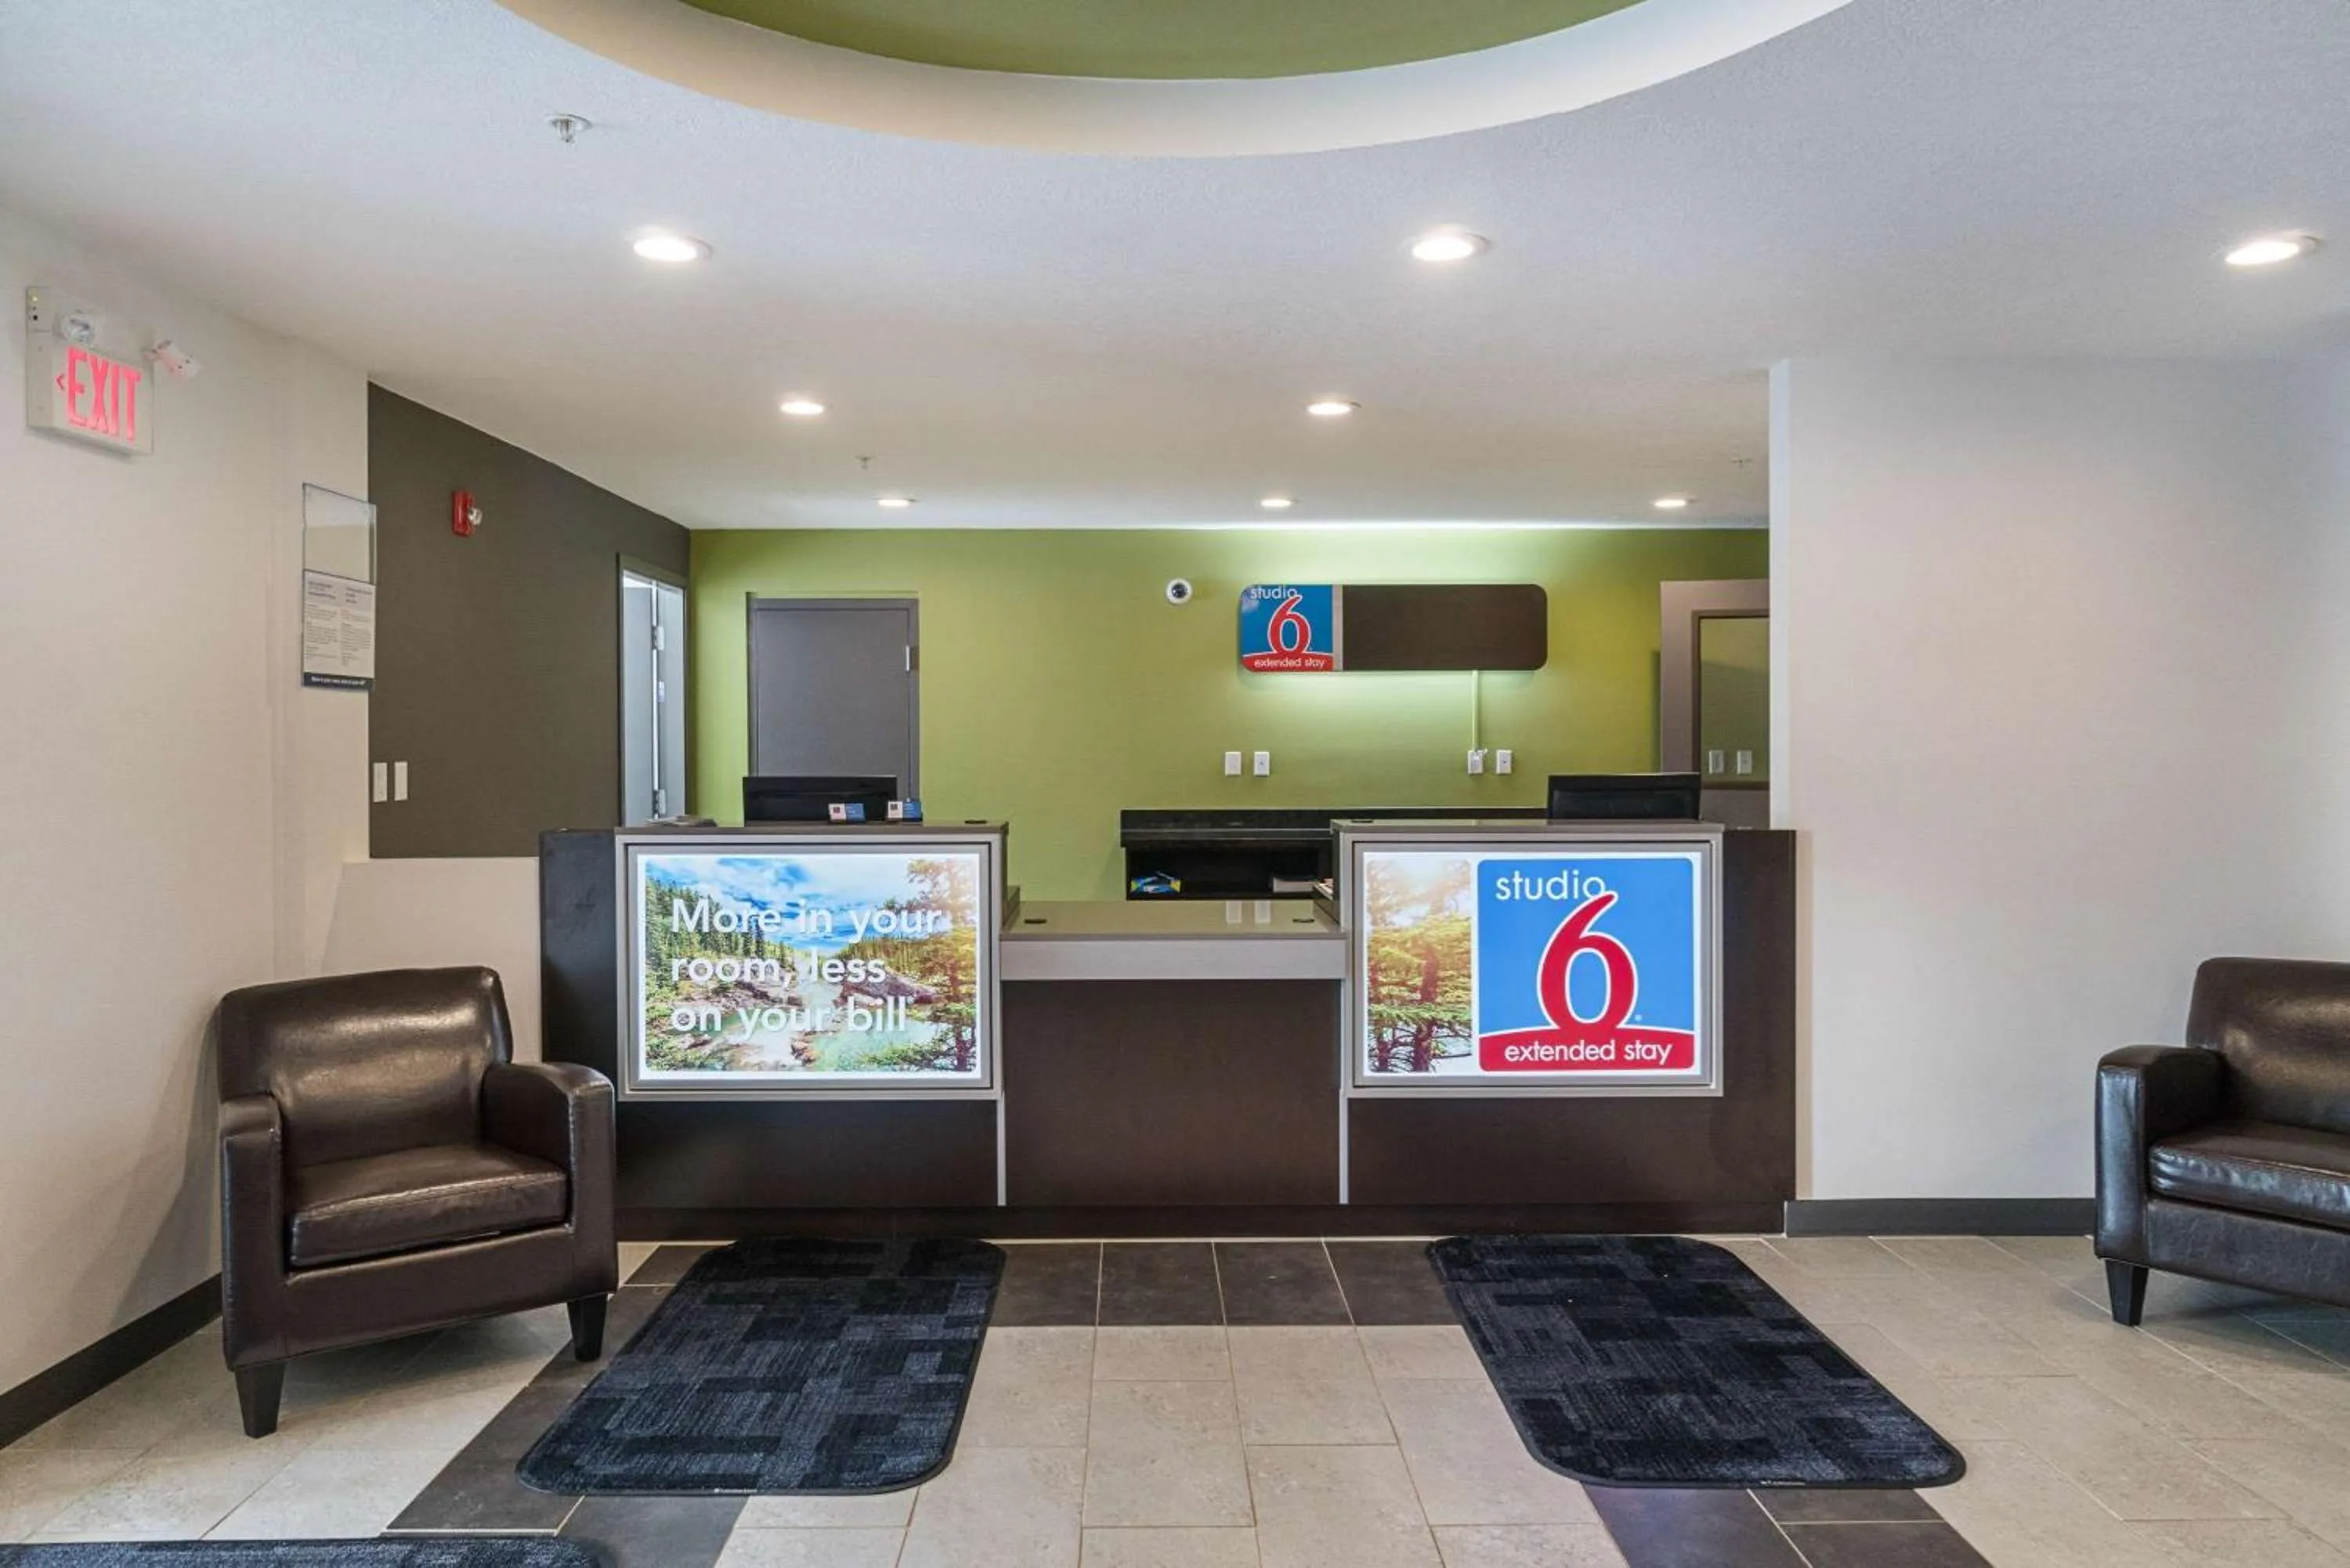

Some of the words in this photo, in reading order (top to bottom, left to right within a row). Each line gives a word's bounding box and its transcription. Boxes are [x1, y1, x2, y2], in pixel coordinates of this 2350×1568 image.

[67, 347, 142, 442] EXIT
[1250, 585, 1297, 599] studio
[1267, 594, 1311, 653] 6
[1254, 657, 1301, 668] extended
[1304, 658, 1325, 669] stay
[1495, 869, 1606, 901] studio
[672, 898, 782, 933] More
[799, 898, 833, 934] in
[849, 909, 942, 943] your
[671, 957, 790, 987] room,
[810, 946, 887, 984] less
[1537, 891, 1640, 1028] 6
[671, 1006, 722, 1032] on
[738, 1006, 831, 1043] your
[848, 995, 906, 1032] bill
[1504, 1039, 1615, 1062] extended
[1623, 1040, 1672, 1065] stay
